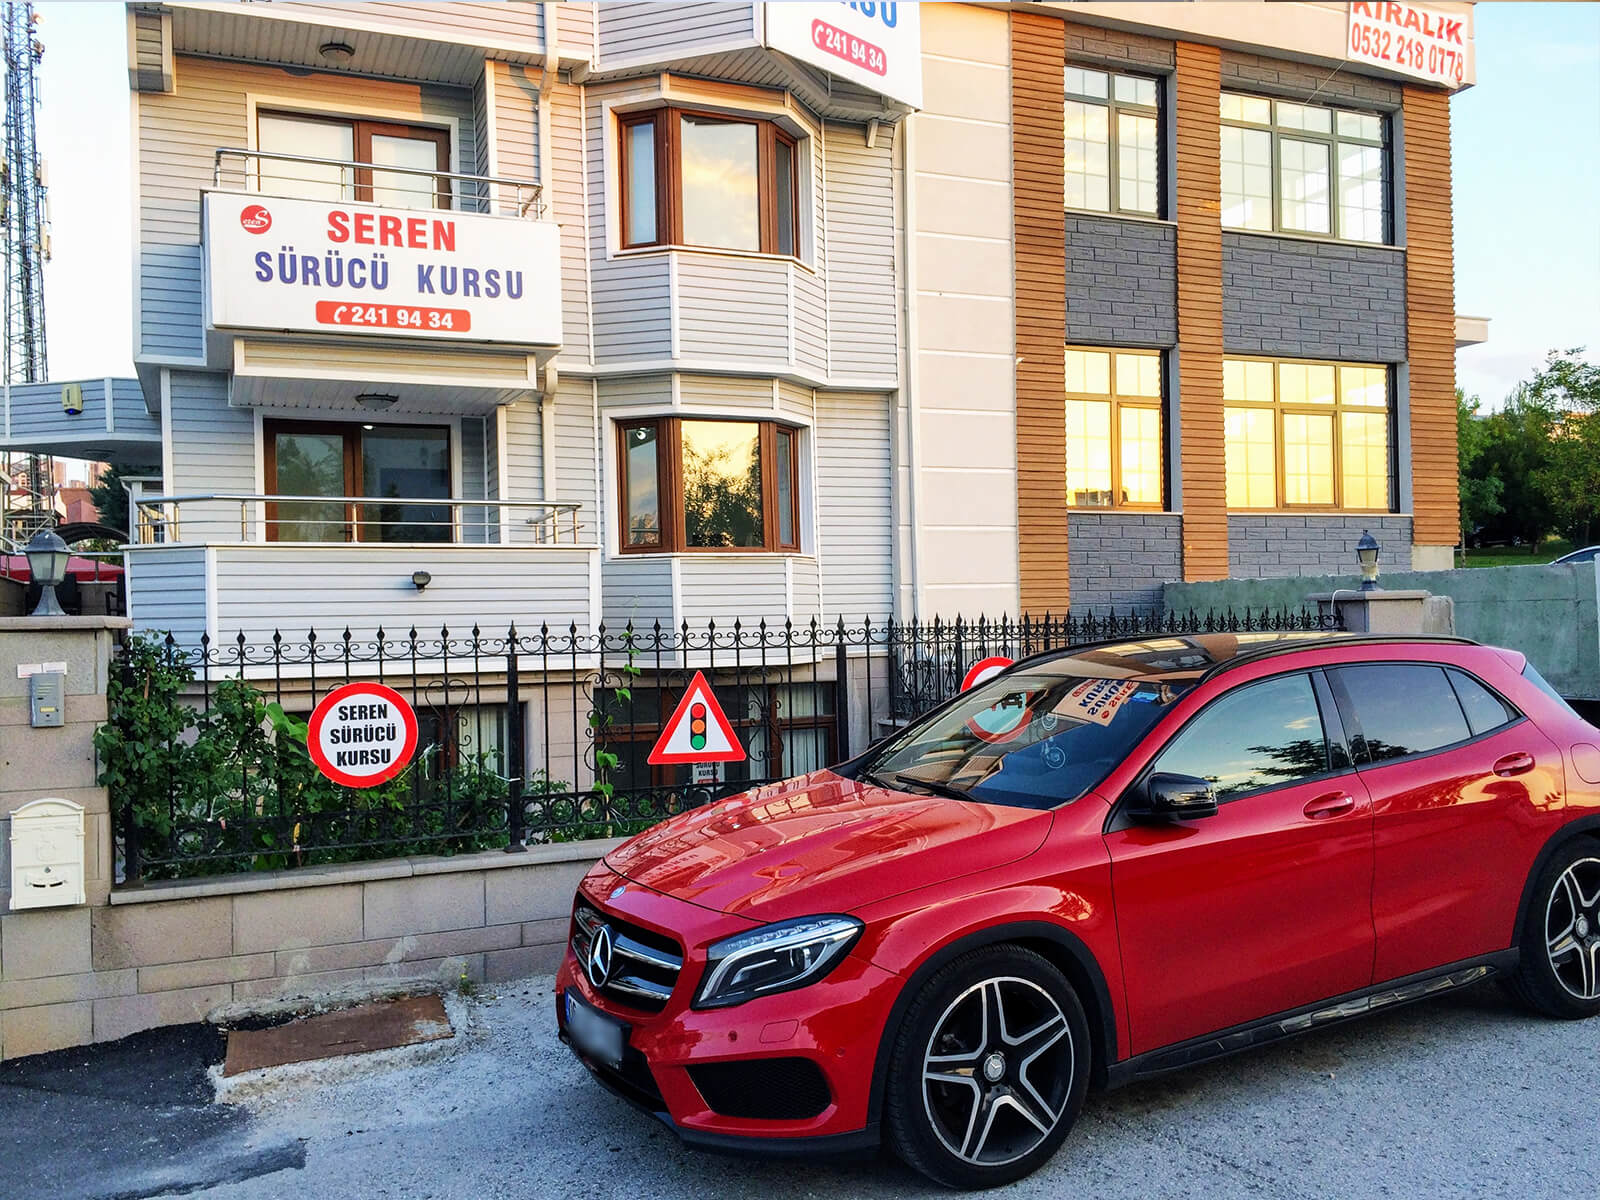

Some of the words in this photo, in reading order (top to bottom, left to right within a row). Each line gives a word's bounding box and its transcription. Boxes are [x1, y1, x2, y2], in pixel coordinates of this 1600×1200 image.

[826, 29, 847, 55] 241
[851, 40, 866, 63] 94
[869, 48, 884, 71] 34
[1352, 22, 1391, 60] 0532
[1396, 35, 1424, 70] 218
[1429, 44, 1463, 82] 0778
[327, 211, 456, 252] SEREN
[255, 246, 389, 290] SÜRÜCÜ
[418, 264, 523, 299] KURSU
[351, 306, 388, 325] 241
[397, 308, 422, 327] 94
[429, 310, 453, 329] 34
[338, 703, 388, 721] SEREN
[330, 723, 396, 744] SÜRÜCÜ
[336, 748, 391, 767] KURSU
